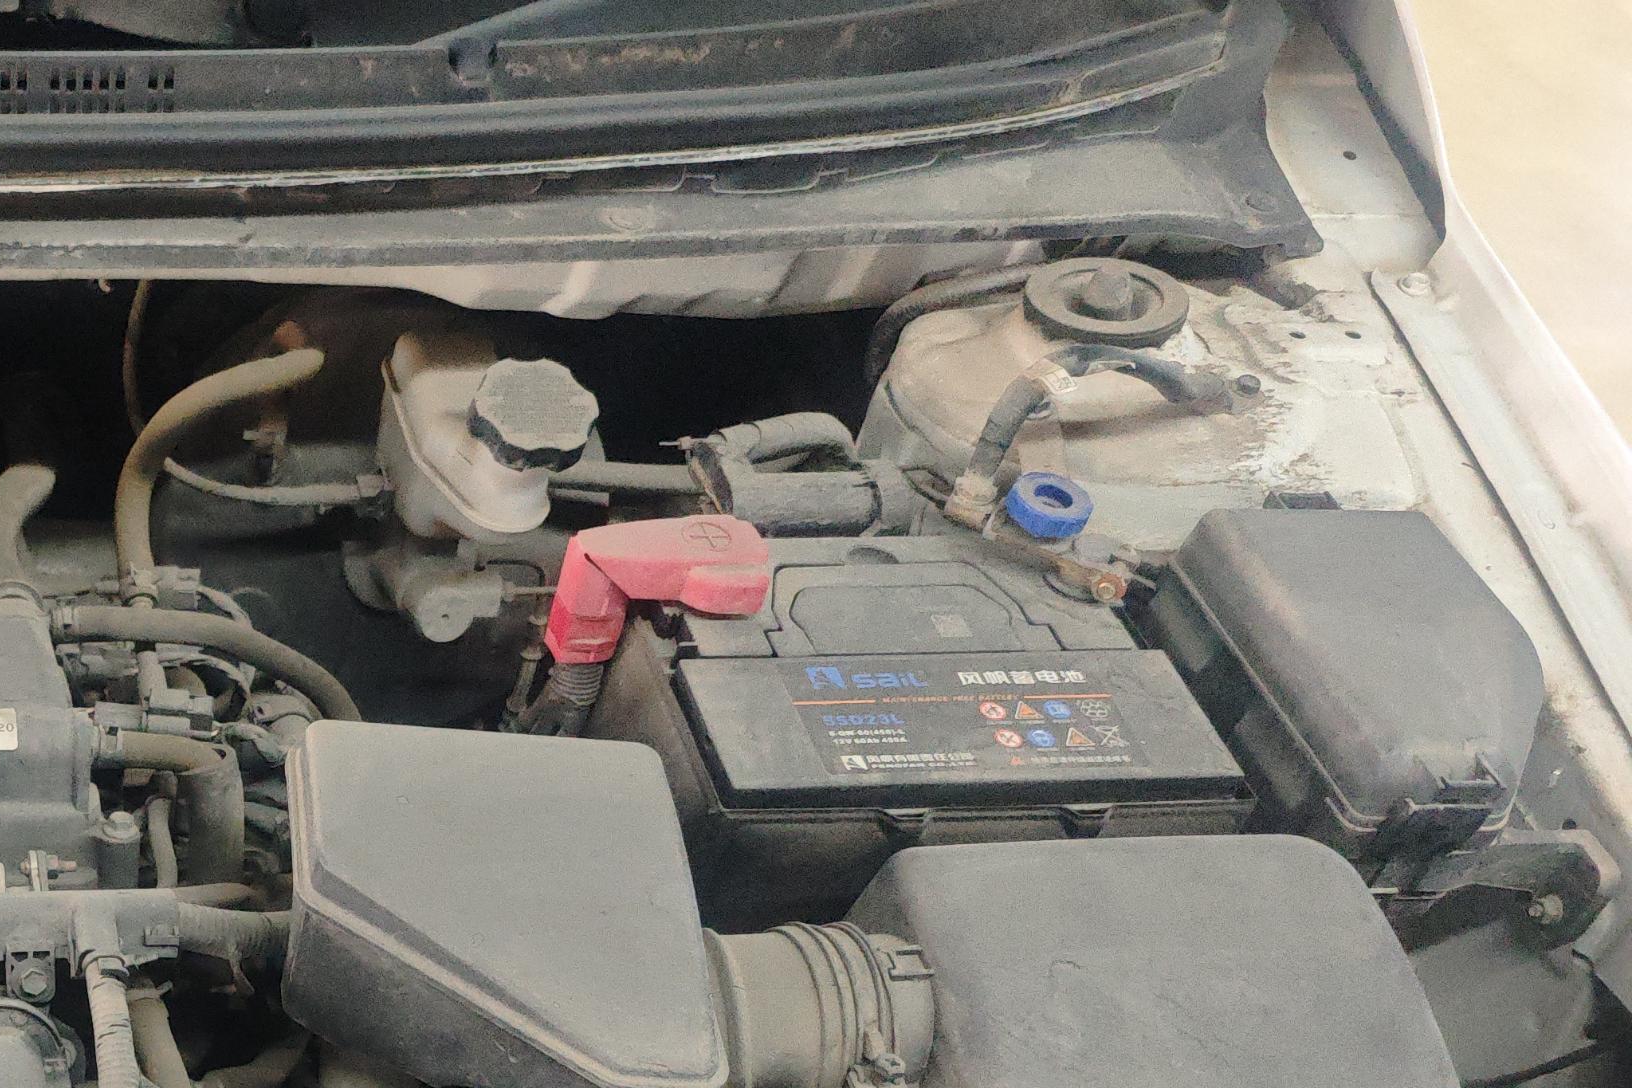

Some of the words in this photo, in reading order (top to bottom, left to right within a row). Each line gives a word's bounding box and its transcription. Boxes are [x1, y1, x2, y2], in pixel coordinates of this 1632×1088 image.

[957, 669, 1087, 686] 风帆蓄电池
